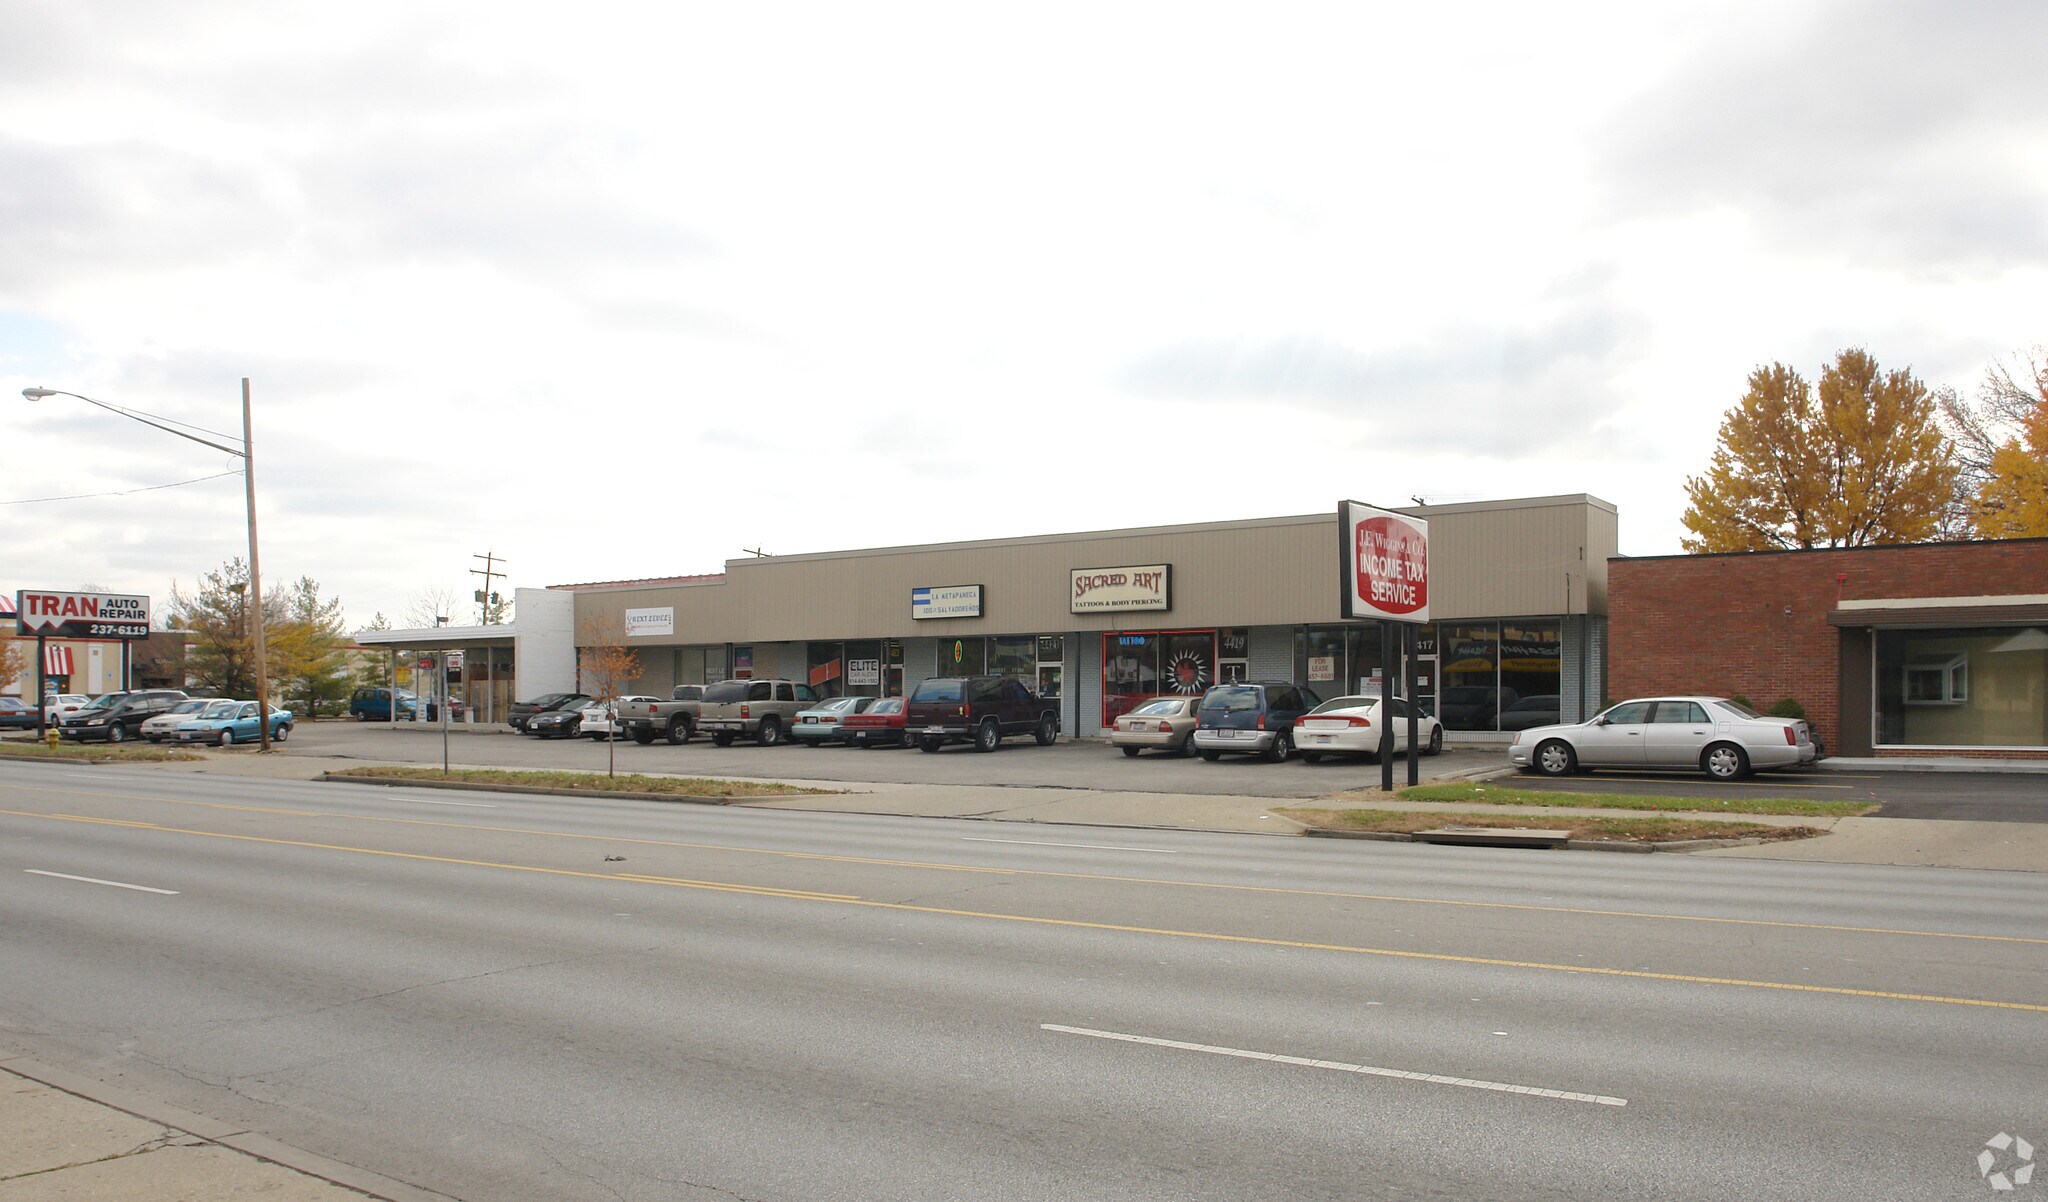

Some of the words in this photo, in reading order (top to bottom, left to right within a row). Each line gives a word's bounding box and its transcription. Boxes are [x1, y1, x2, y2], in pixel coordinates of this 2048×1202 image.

[1360, 553, 1403, 580] INCOME
[1404, 561, 1424, 583] TAX
[1075, 573, 1127, 598] SACRED
[1132, 572, 1162, 594] ART
[1371, 580, 1416, 606] SERVICE
[26, 594, 98, 617] TRAN
[106, 598, 139, 609] AUTO
[1131, 598, 1163, 606] PIERCING
[99, 608, 146, 620] REPAIR
[90, 624, 148, 636] 237-6119
[1119, 637, 1145, 645] TATTOO
[1224, 636, 1244, 649] 4419
[850, 660, 877, 671] ELITE
